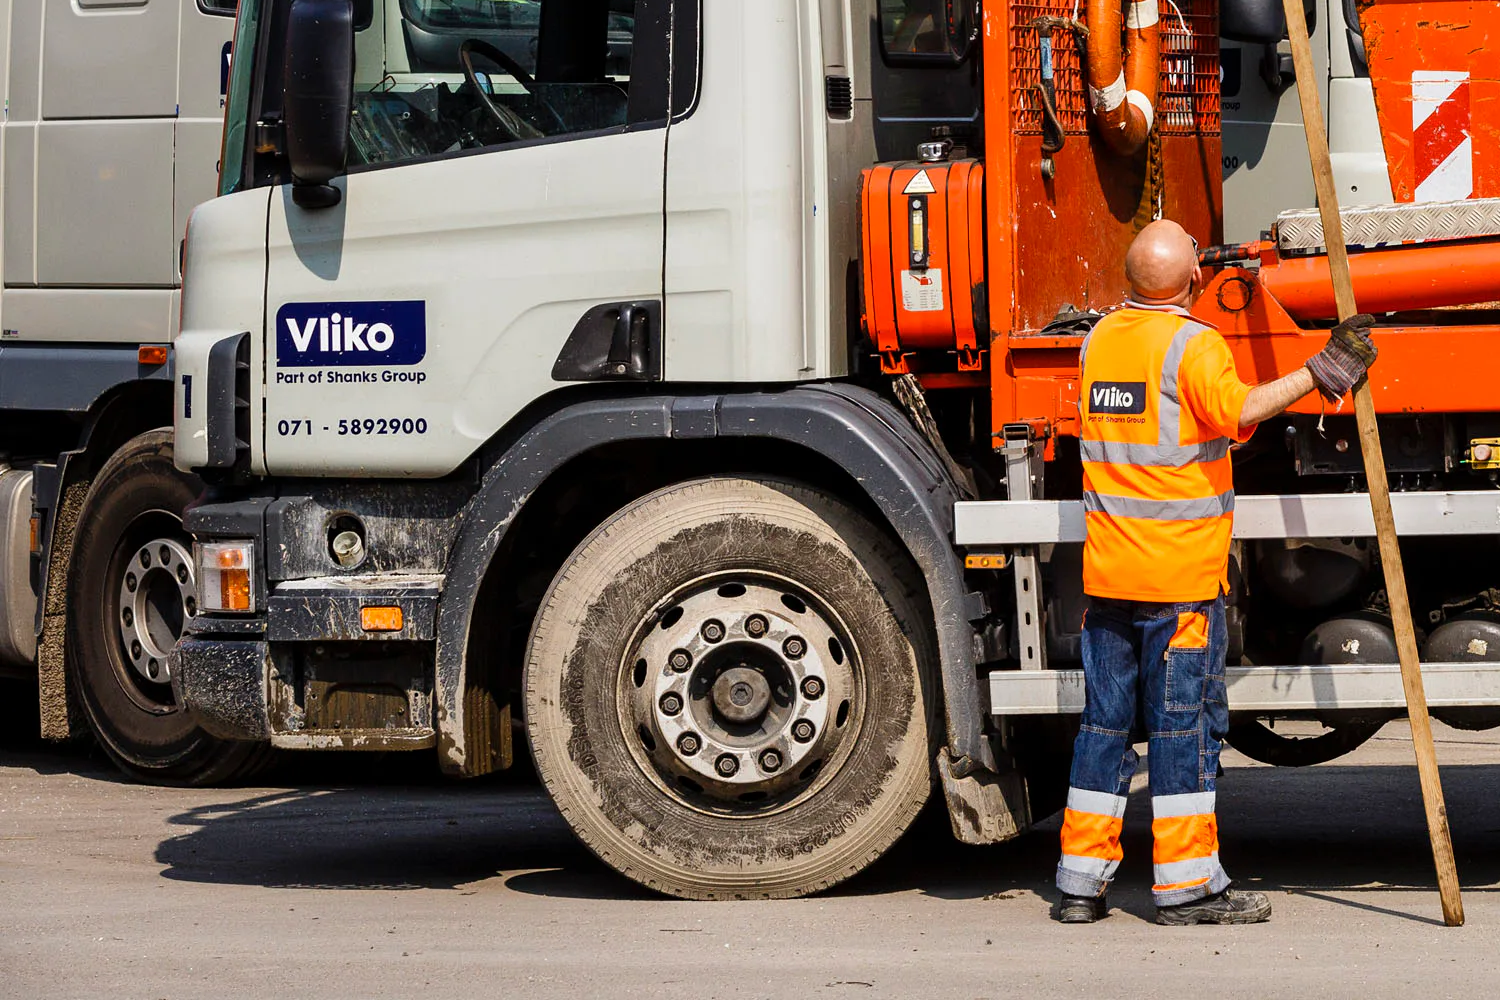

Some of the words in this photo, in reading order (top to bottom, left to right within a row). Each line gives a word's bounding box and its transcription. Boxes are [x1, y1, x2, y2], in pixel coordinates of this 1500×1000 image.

[285, 312, 395, 352] Vliko
[276, 371, 304, 384] Part
[308, 371, 323, 384] of
[327, 371, 377, 384] Shanks
[381, 370, 427, 385] Group
[1092, 386, 1134, 408] Vliko
[278, 420, 312, 436] 071
[337, 418, 428, 436] 5892900
[1126, 416, 1146, 425] Group
